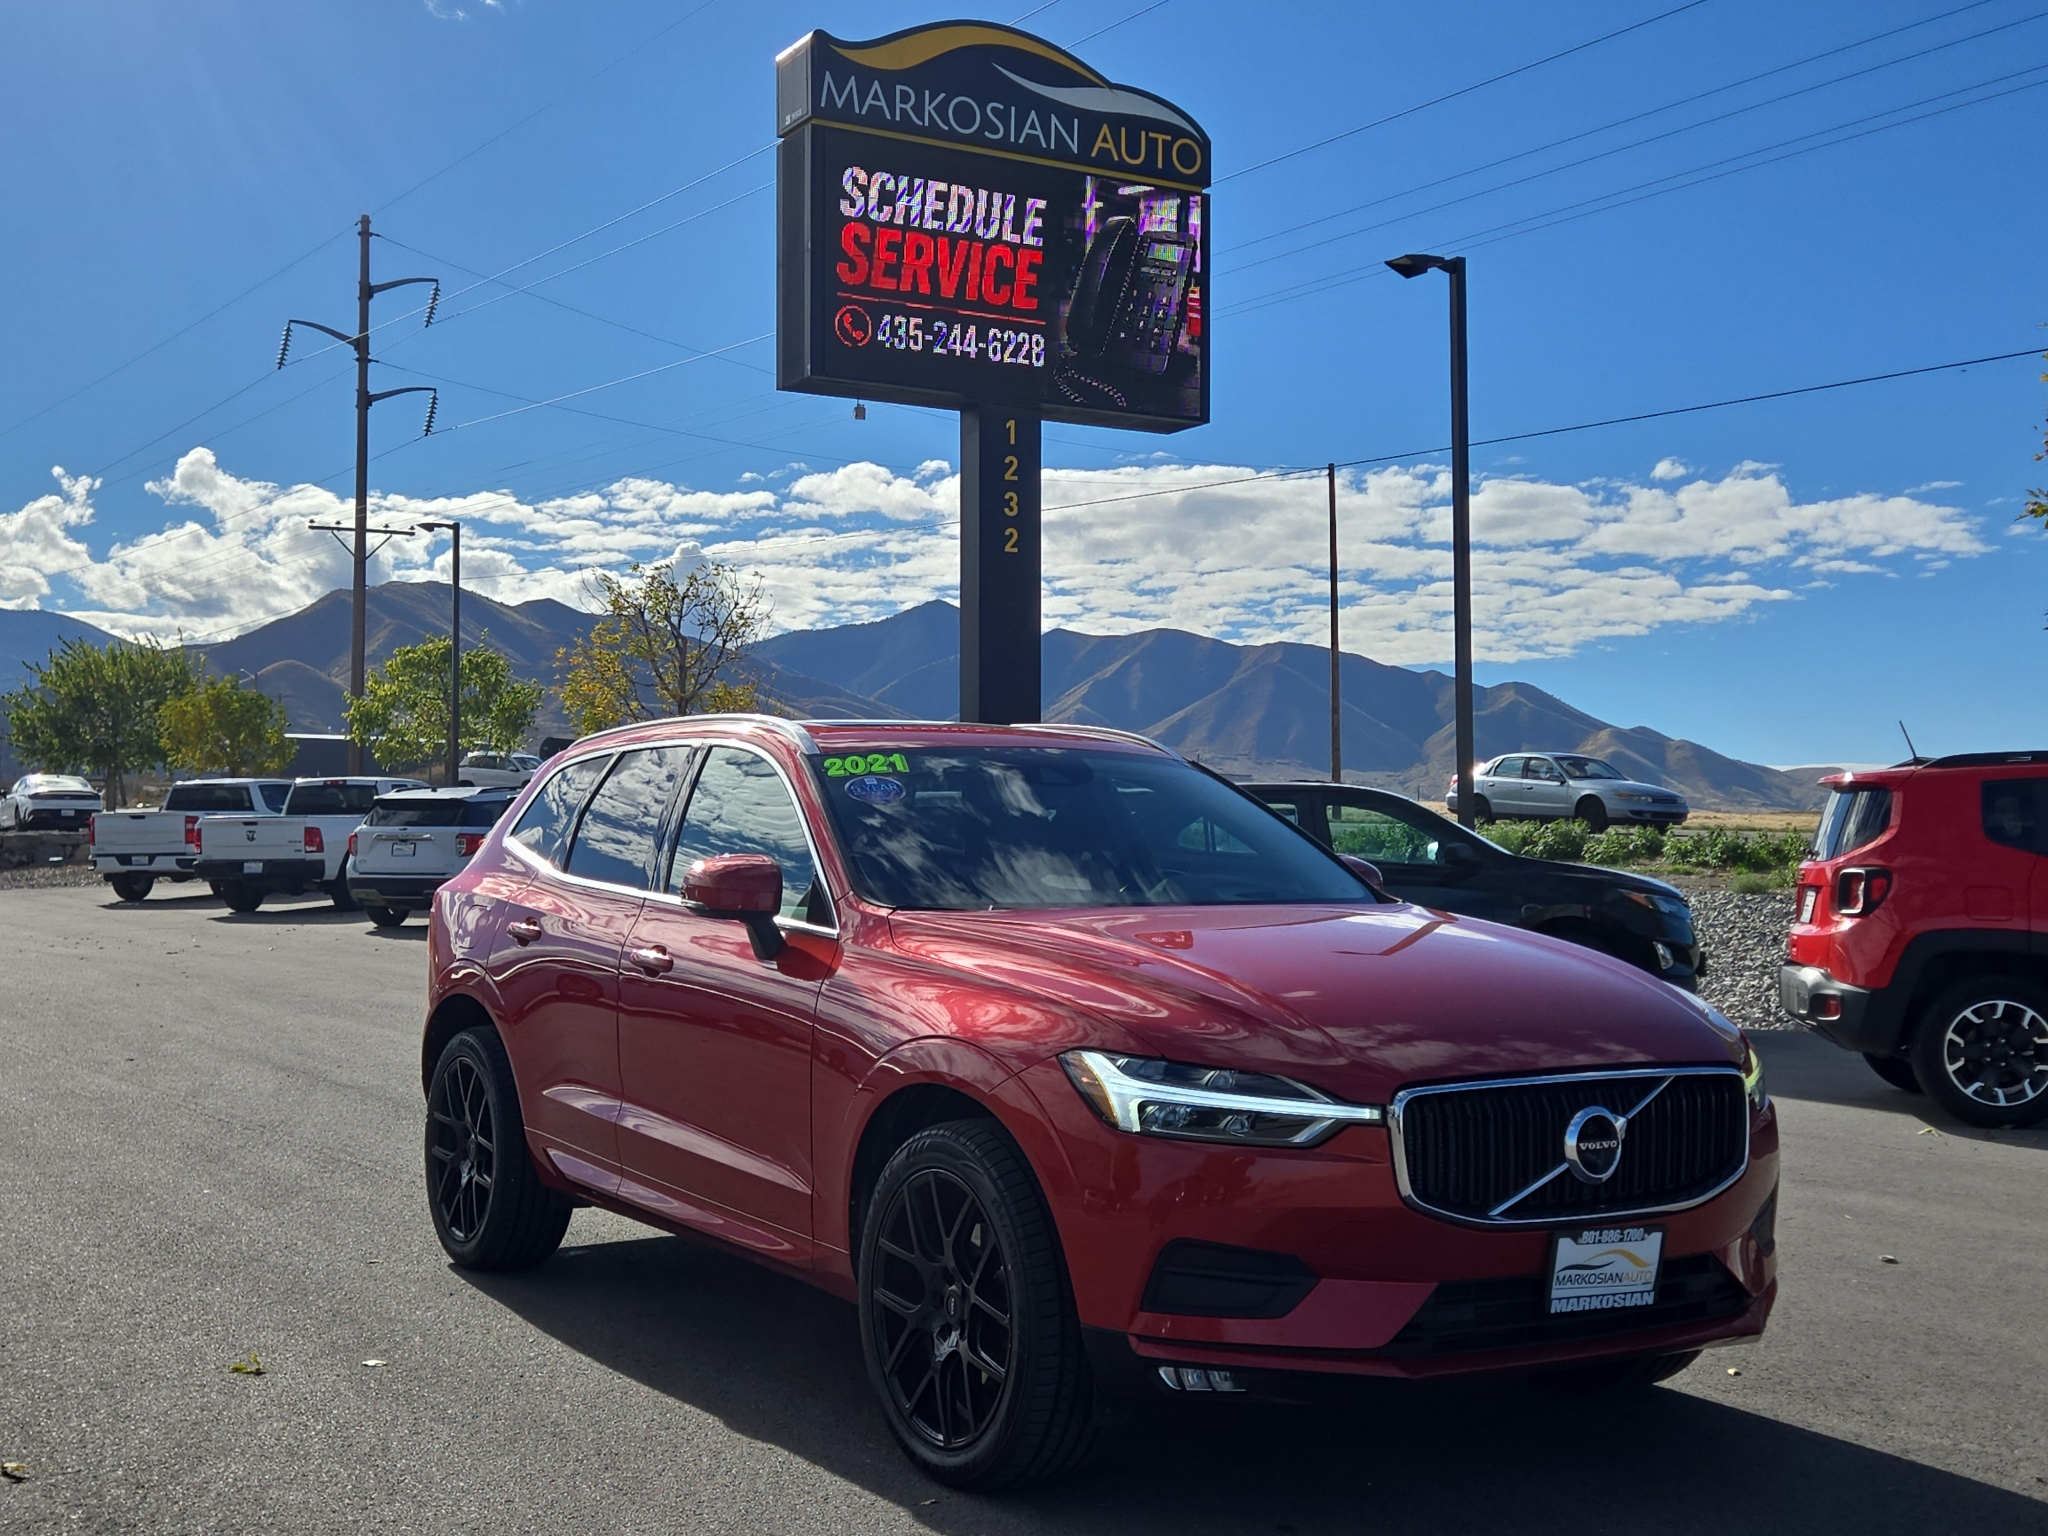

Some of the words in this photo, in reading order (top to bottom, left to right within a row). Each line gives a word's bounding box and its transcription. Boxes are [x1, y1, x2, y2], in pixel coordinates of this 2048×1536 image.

[820, 71, 1078, 154] MARKOSIAN
[1091, 123, 1202, 175] AUTO
[840, 166, 1048, 246] SCHEDULE
[837, 222, 1043, 309] SERVICE
[877, 314, 1045, 367] 435-244-6228
[824, 753, 910, 777] 2021
[1579, 1140, 1618, 1151] VOLVO
[1550, 1291, 1655, 1314] MARKOSIAN
